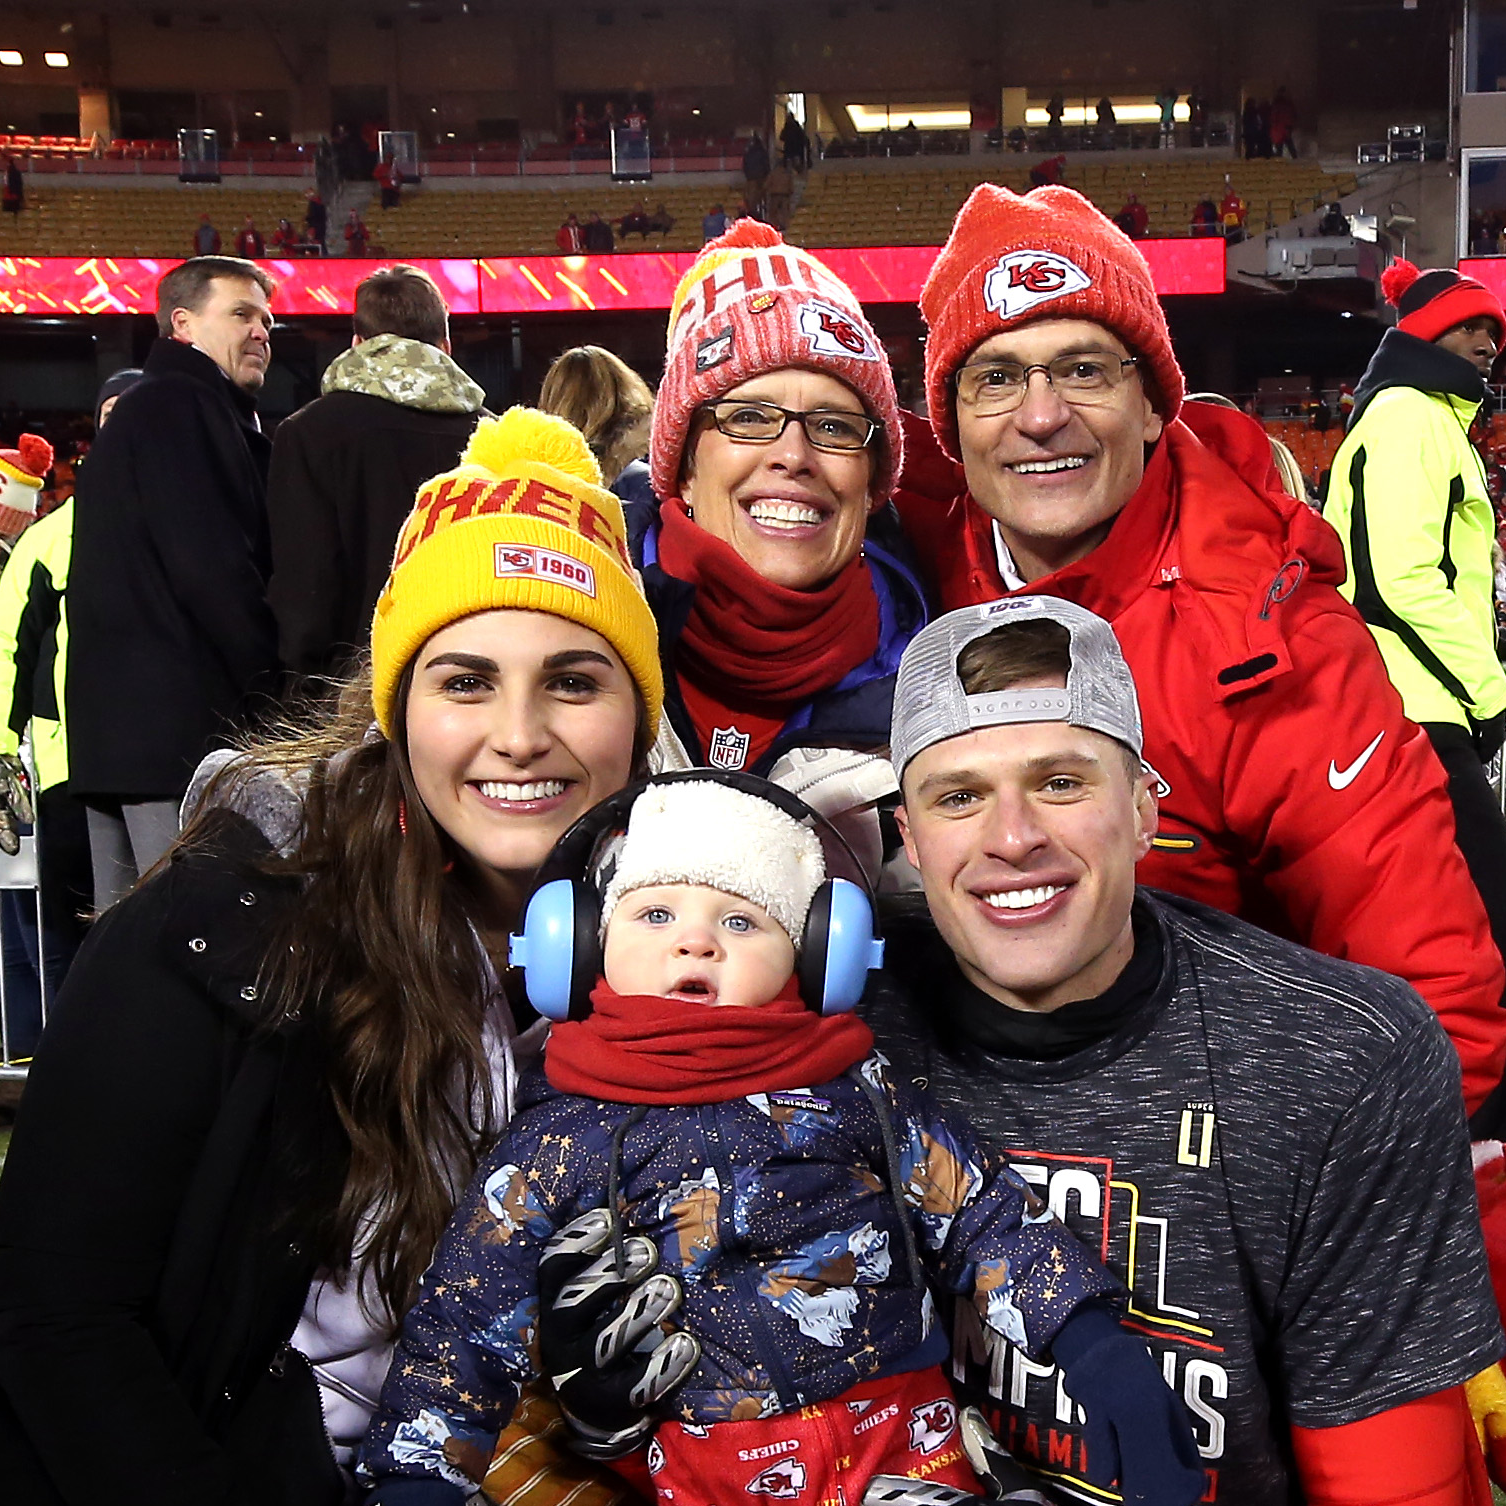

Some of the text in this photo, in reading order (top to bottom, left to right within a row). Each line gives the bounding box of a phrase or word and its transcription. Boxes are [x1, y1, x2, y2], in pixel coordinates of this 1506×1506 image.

[540, 556, 586, 584] 1960
[715, 746, 741, 765] NFL
[853, 1403, 900, 1435] CHIEFS
[738, 1439, 800, 1461] CHIEFS
